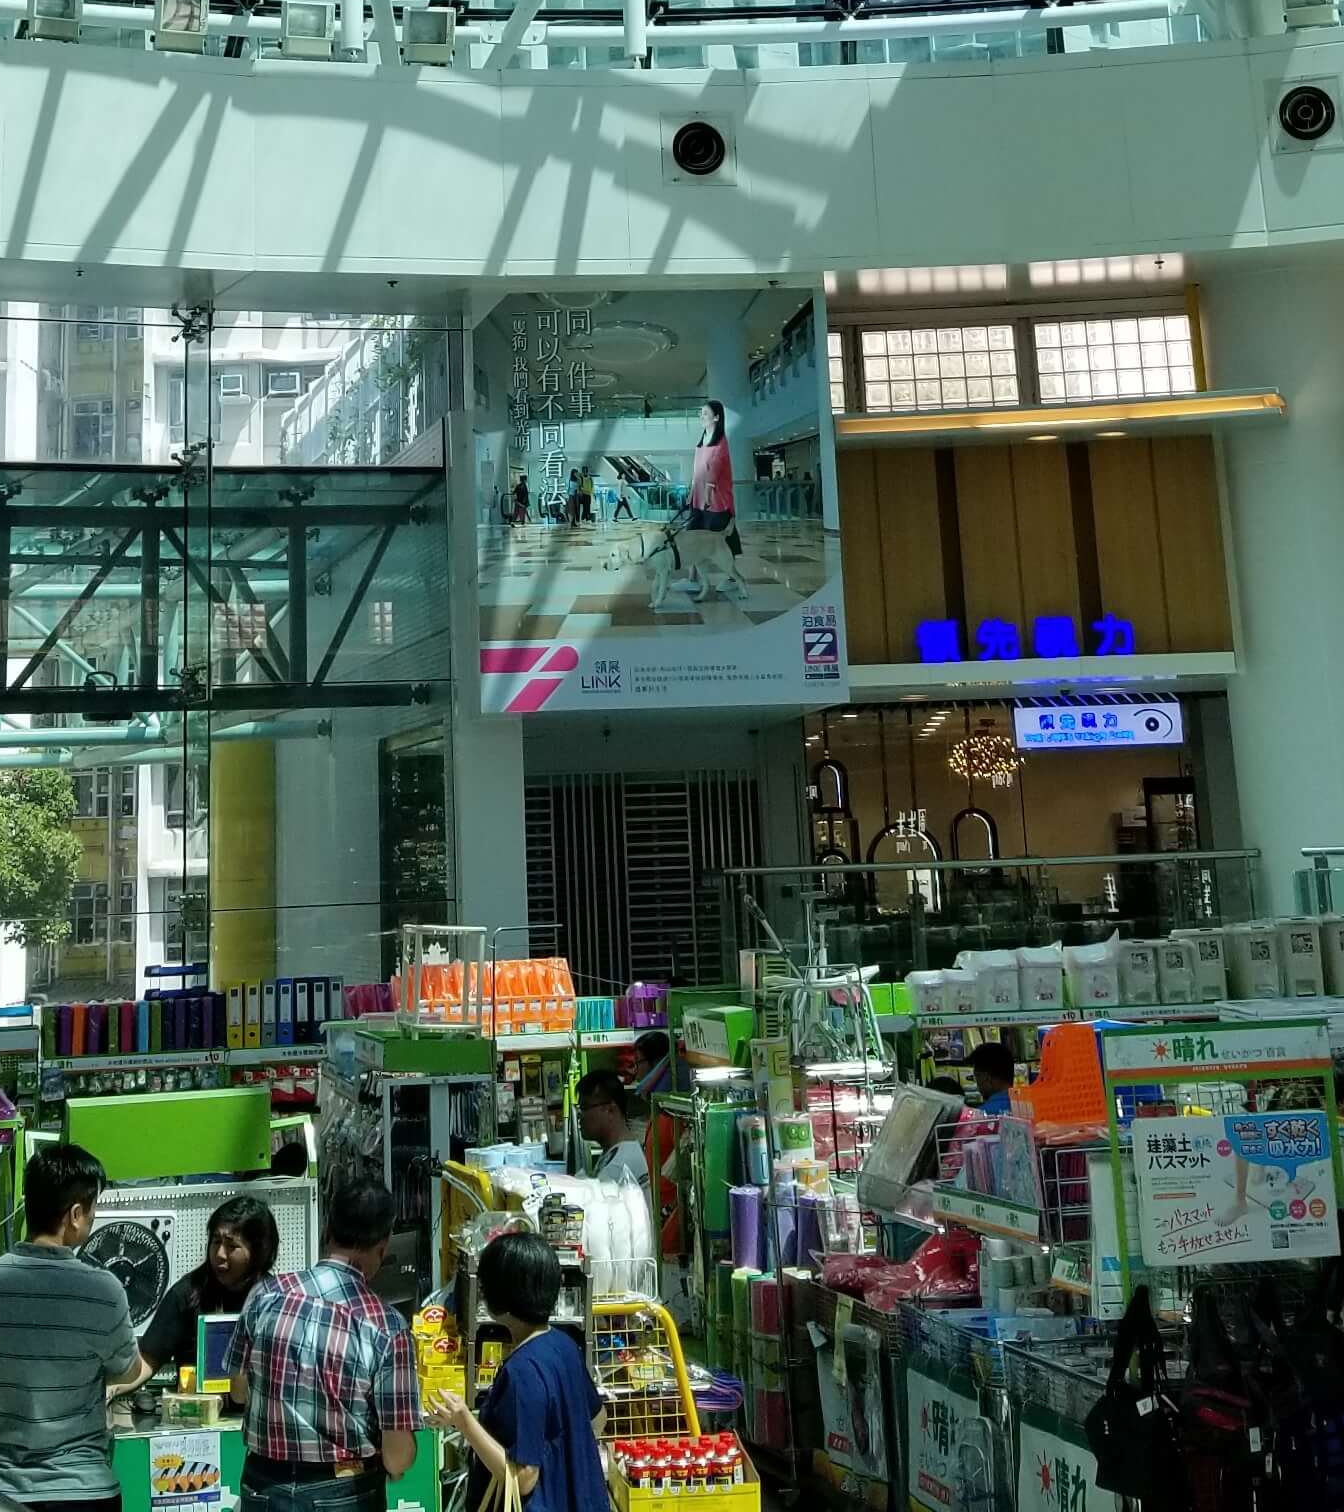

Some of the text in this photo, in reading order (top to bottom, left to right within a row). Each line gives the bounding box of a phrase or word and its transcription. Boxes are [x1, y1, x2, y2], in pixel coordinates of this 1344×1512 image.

[565, 308, 595, 418] 同一件事
[535, 308, 568, 507] 可以有不同看法
[594, 660, 621, 674] 領展
[581, 674, 622, 689] LINK
[1172, 1035, 1218, 1062] 晴れ
[1264, 1118, 1320, 1140] すぐ乾く
[1146, 1137, 1193, 1153] 珪藻土
[1148, 1153, 1211, 1170] バスマット
